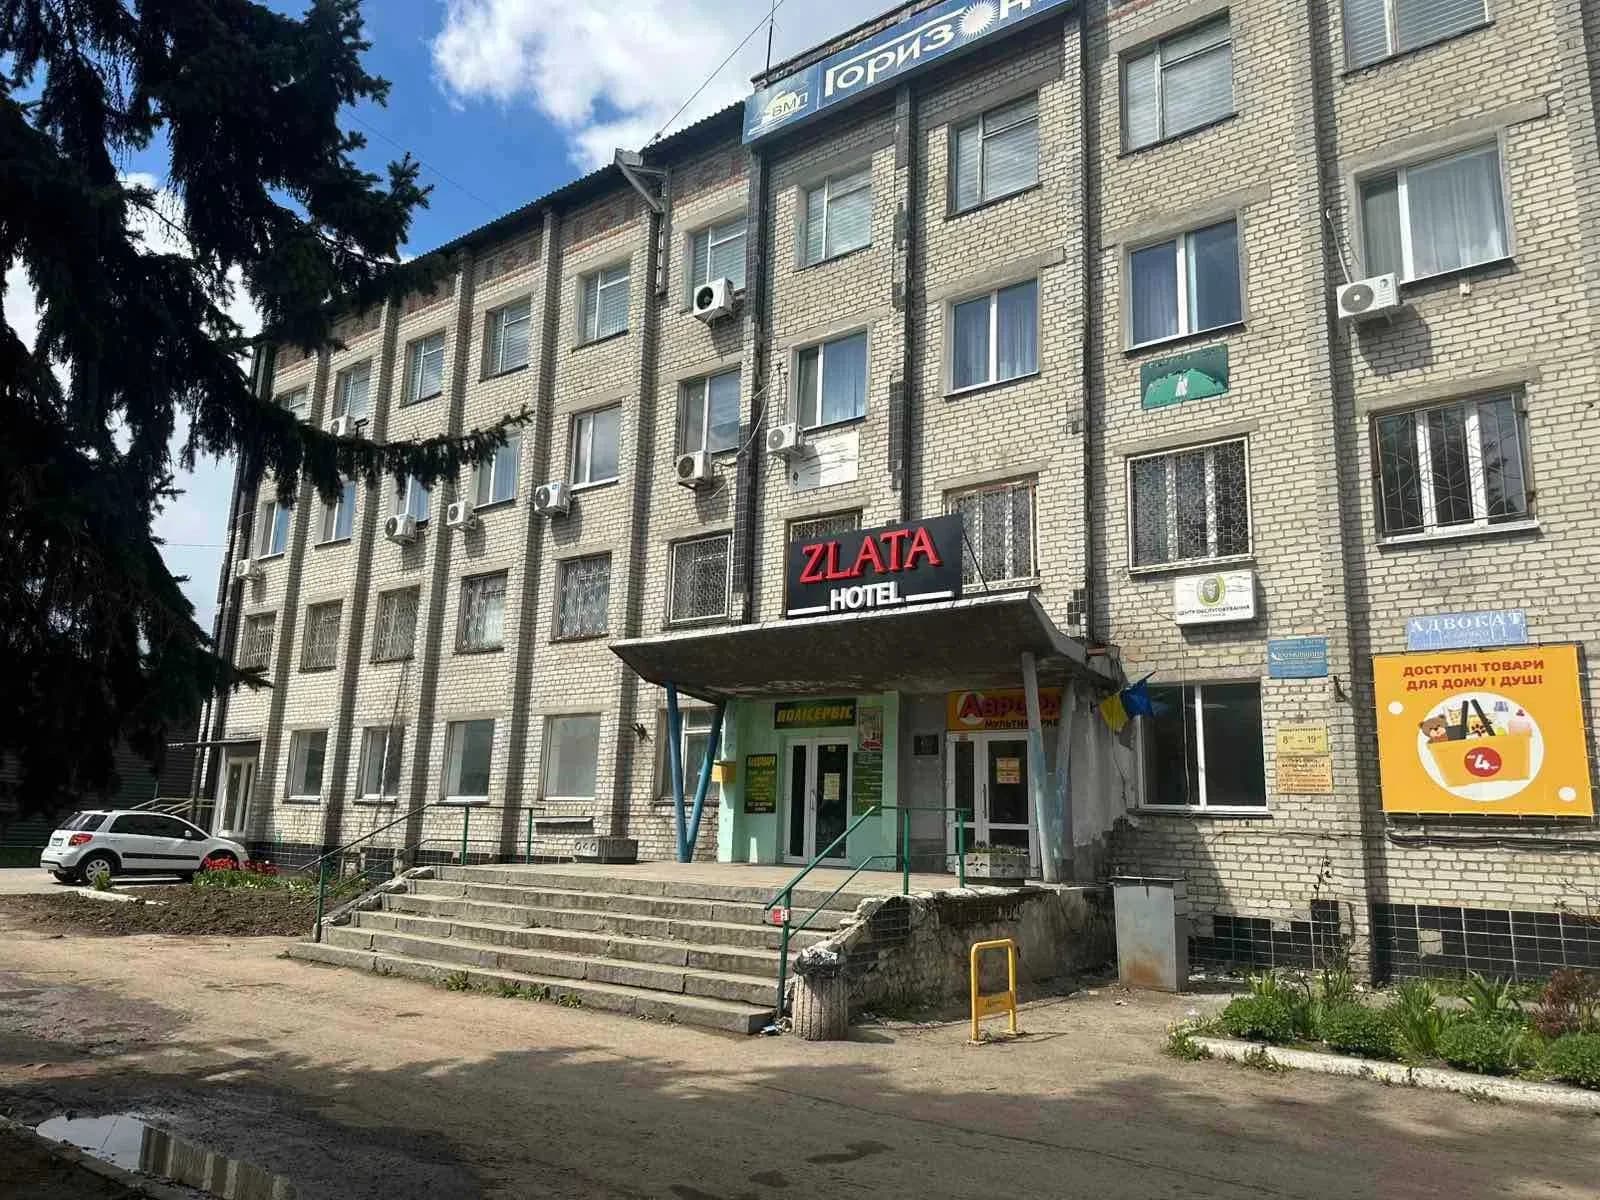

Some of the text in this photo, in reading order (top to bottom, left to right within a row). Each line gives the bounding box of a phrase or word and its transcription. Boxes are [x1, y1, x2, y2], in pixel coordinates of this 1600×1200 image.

[799, 527, 944, 584] ZLATA
[830, 581, 905, 611] HOTEL
[1410, 612, 1522, 633] АДВОКАТ
[1403, 659, 1545, 678] ДОСТУПНІ ТОВАРИ
[1406, 674, 1543, 692] ДЛЯ ДОМУ І ДУШІ
